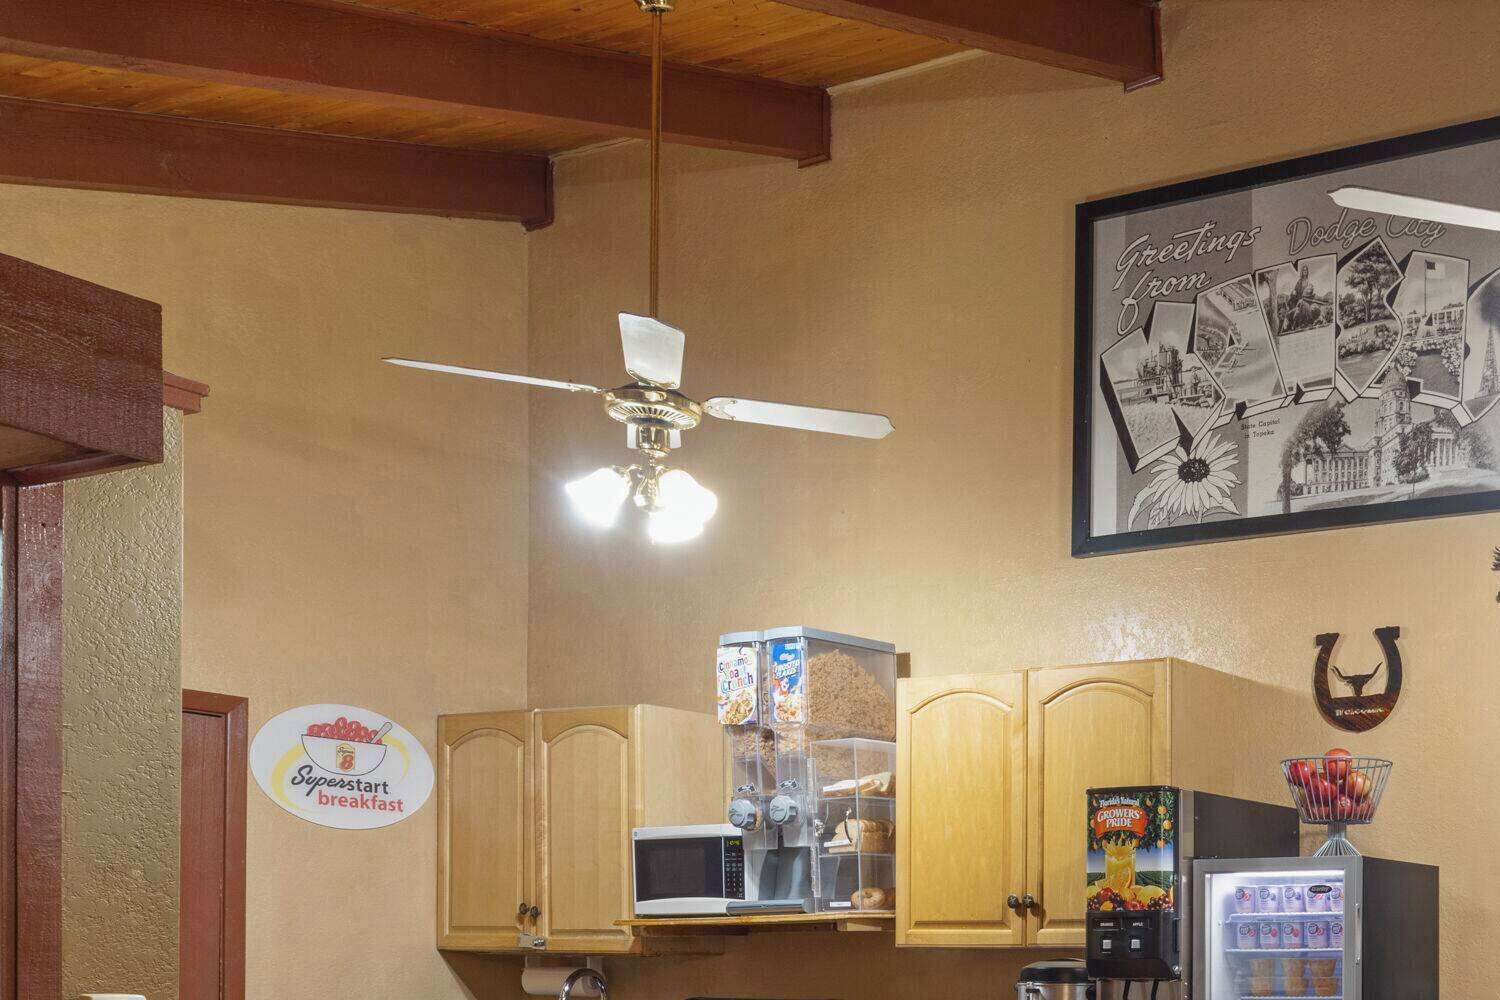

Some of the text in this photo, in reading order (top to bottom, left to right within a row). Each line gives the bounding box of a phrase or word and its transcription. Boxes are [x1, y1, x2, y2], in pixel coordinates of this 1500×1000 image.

[1286, 207, 1377, 256] Dodge
[1112, 220, 1264, 291] Greetings
[1117, 270, 1212, 335] from
[1240, 423, 1256, 431] State
[340, 754, 354, 771] 8
[291, 764, 389, 797] Superstart
[318, 789, 404, 812] breakfast
[1105, 817, 1133, 828] PRIDE
